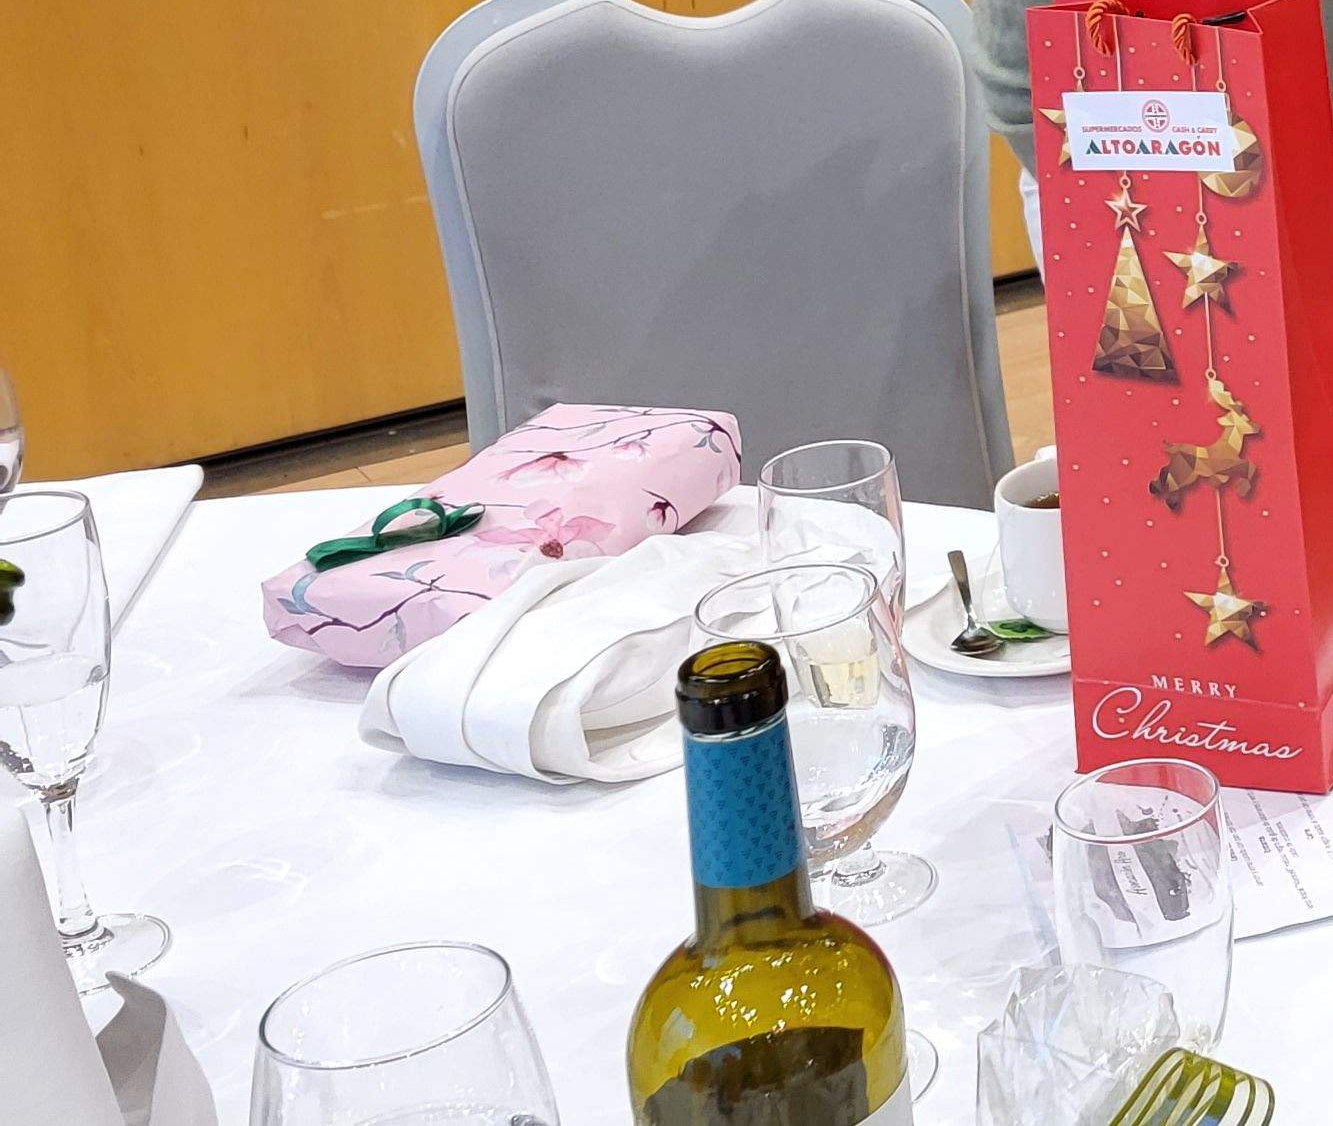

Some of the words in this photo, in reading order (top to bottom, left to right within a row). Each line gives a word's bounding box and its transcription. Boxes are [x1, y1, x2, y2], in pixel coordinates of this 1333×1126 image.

[1085, 135, 1222, 156] ALTOARAGÓN
[1150, 674, 1237, 699] MERRY
[1091, 686, 1304, 760] Christmas
